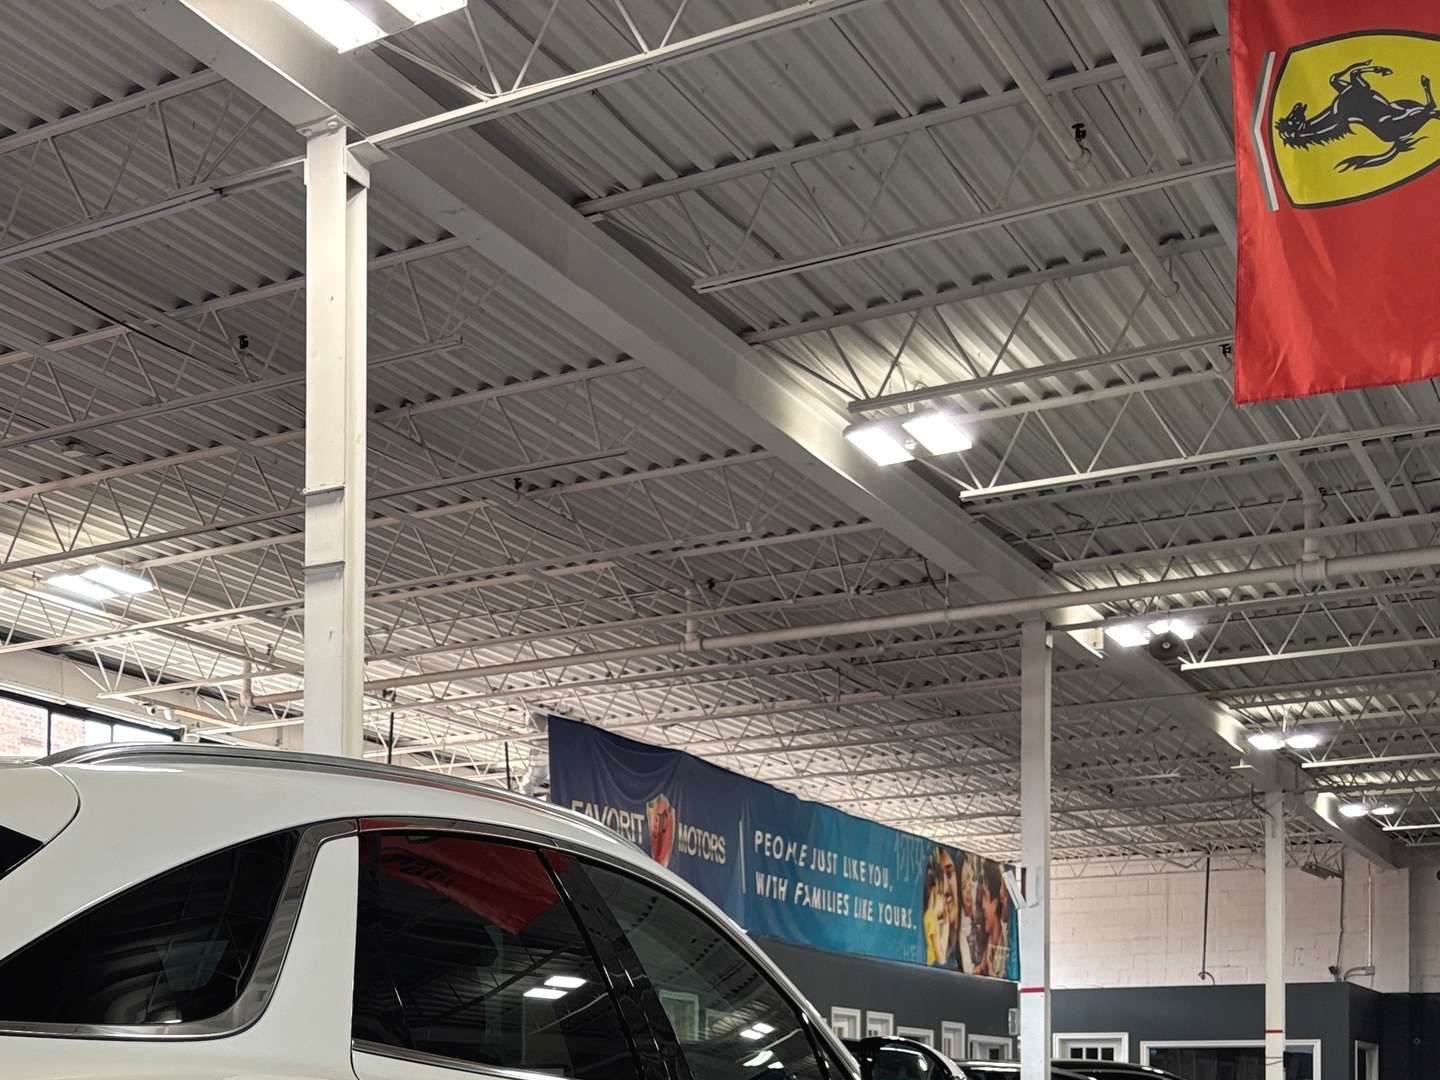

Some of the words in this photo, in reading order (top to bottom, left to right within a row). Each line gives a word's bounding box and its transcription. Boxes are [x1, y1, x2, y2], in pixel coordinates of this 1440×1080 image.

[678, 822, 726, 865] MOTORS
[810, 847, 838, 875] JUST
[843, 855, 866, 882] LIKE
[868, 863, 894, 893] YOU,
[755, 871, 789, 902] WITH
[794, 882, 850, 917] FAMILIES
[854, 895, 873, 922] LIKE
[878, 902, 918, 930] YOURS.
